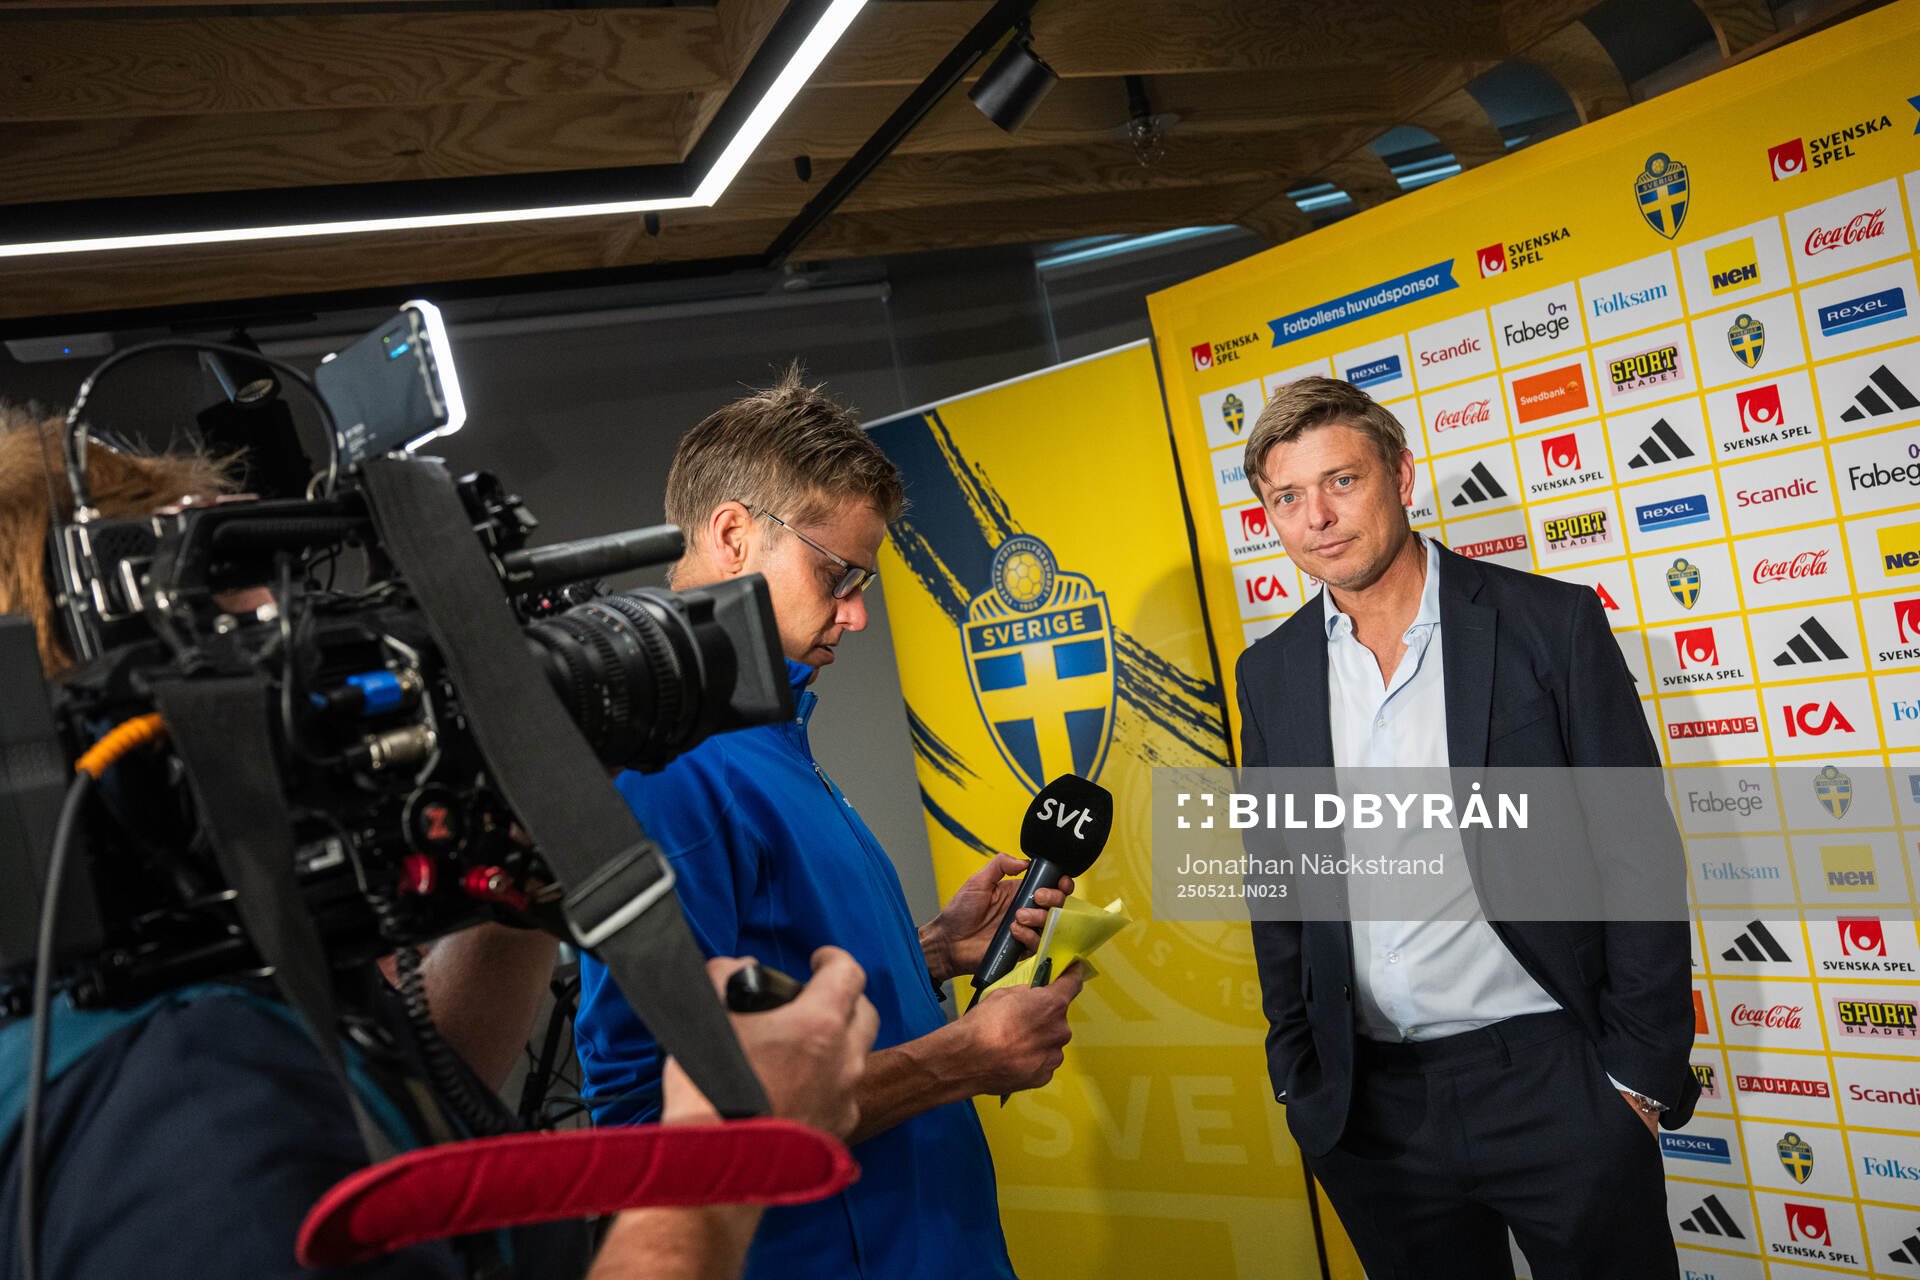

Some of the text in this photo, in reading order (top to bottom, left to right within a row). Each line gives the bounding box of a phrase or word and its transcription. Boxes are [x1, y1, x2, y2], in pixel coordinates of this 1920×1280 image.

[1809, 115, 1892, 153] SVENSKA
[1812, 146, 1855, 168] SPEL
[1508, 227, 1571, 256] SVENSKA
[1804, 208, 1887, 256] Coca-Cola
[1510, 251, 1543, 269] SPEL
[1282, 273, 1441, 337] Fotbollens huvudsponsor
[1592, 284, 1668, 317] Folksam
[1504, 316, 1569, 346] Fabege
[1214, 332, 1260, 354] SVENSKA
[1420, 337, 1481, 367] Scandic
[1216, 349, 1241, 366] SPEL
[1610, 346, 1679, 383] SPORT
[1617, 371, 1679, 392] BLADET
[1520, 386, 1566, 407] Swedbank
[1723, 425, 1812, 452] SVENSKA SPEL
[1220, 466, 1248, 485] Folk
[1531, 471, 1605, 493] SVENSKA SPEL
[1849, 463, 1920, 491] Fabeg
[1736, 478, 1819, 507] Scandic
[1411, 508, 1433, 520] SPEL
[1544, 511, 1607, 544] SPORT
[1233, 539, 1281, 556] SVENSKA SPE
[1550, 534, 1607, 551] BLADET
[1245, 575, 1289, 605] ICA
[982, 610, 1086, 648] SVERIGE
[1879, 648, 1920, 662] SVENS
[1663, 669, 1744, 686] SVENSKA SPEL
[1669, 718, 1757, 738] BAUHAUS
[1783, 700, 1856, 738] ICA
[1688, 791, 1764, 816] Fabege
[1036, 797, 1094, 841] svt
[1701, 862, 1780, 881] Folksam
[1823, 961, 1916, 972] SVENSKA SPEL
[1838, 1002, 1918, 1028] SPORT
[1846, 1026, 1917, 1036] BLADET
[1738, 1077, 1828, 1097] BAUHAUS
[1849, 1084, 1920, 1105] Scandi
[1863, 1157, 1920, 1180] Folks
[1772, 1242, 1858, 1265] SVENSKA SPEL
